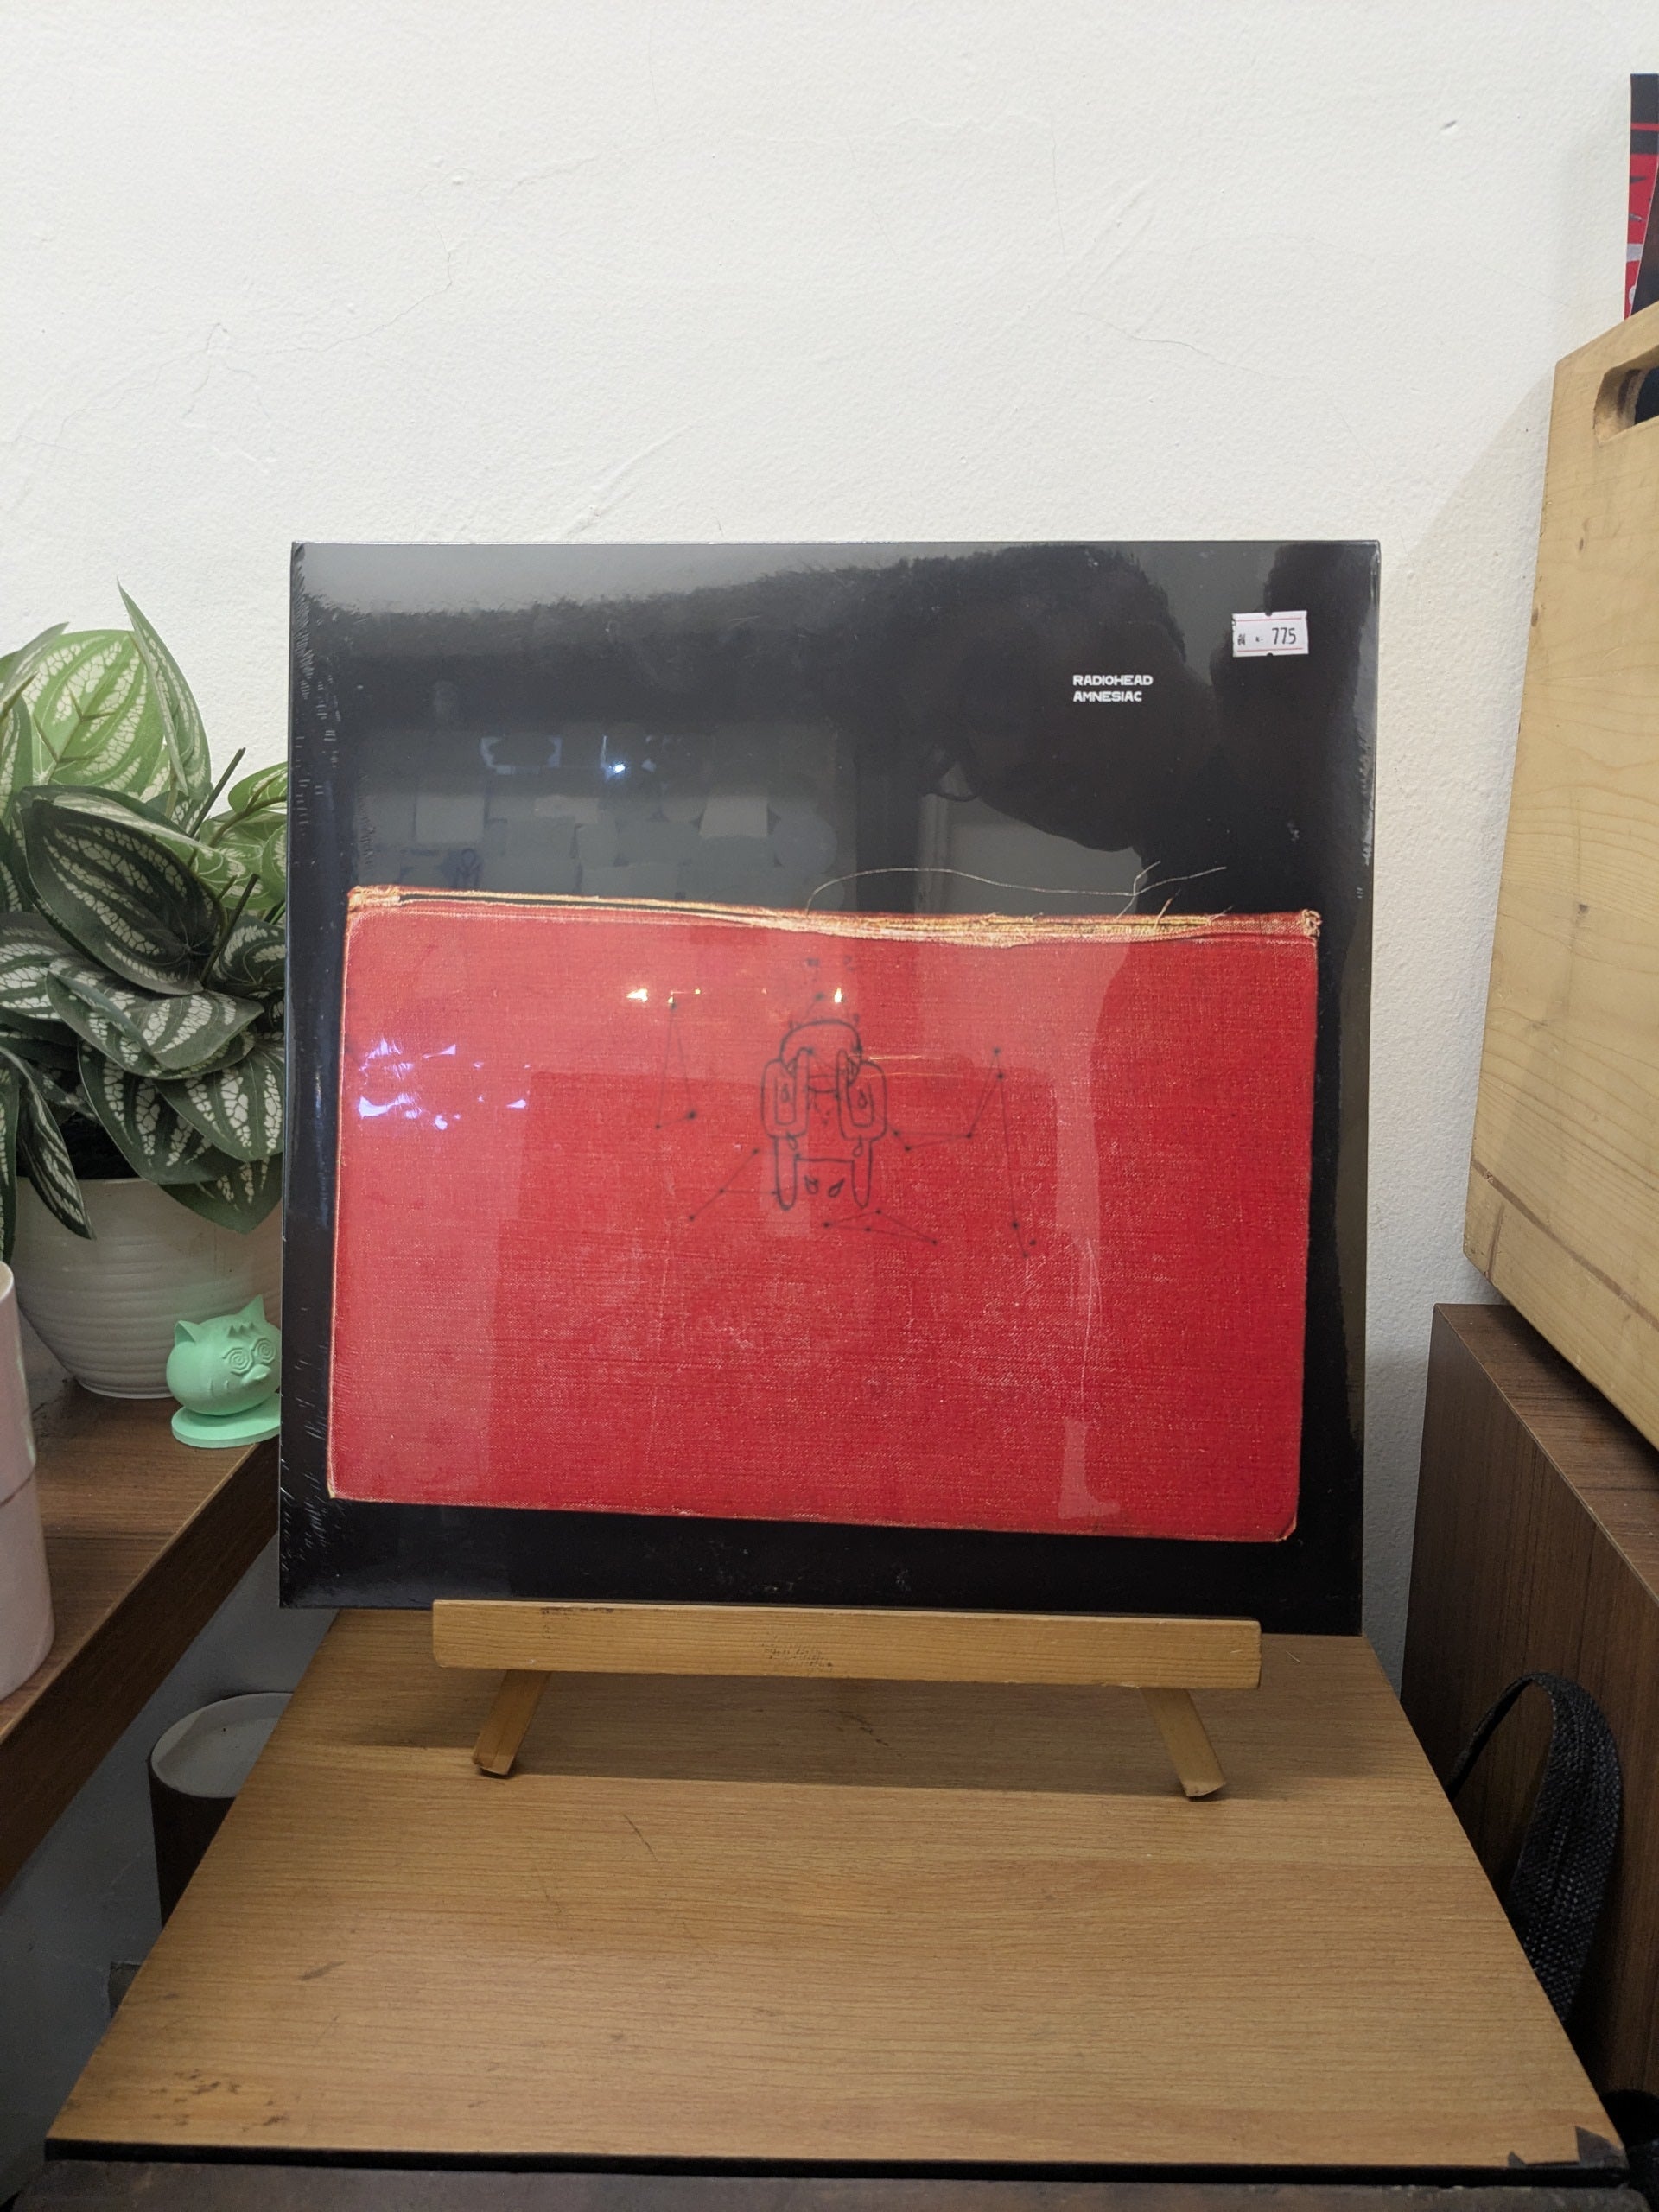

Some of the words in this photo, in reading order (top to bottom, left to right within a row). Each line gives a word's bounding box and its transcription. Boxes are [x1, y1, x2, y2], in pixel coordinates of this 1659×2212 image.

[1271, 626, 1296, 645] 775
[1072, 674, 1154, 686] RADIOHEAD
[1072, 690, 1142, 702] AMNESIAC
